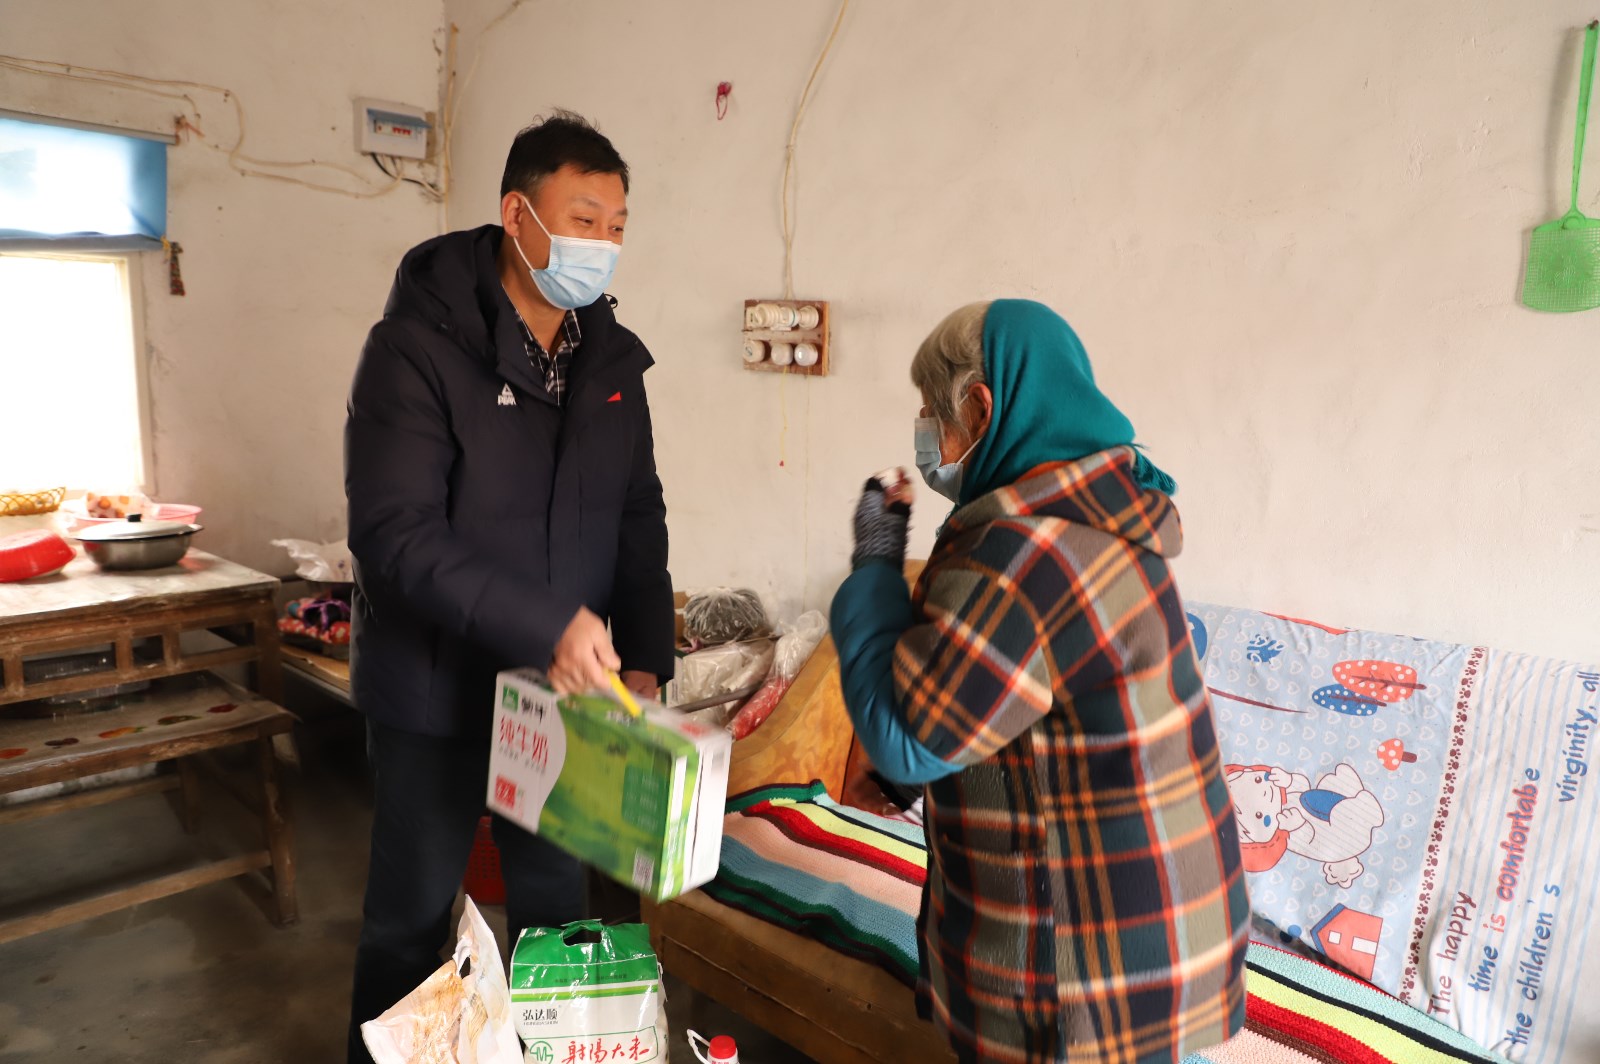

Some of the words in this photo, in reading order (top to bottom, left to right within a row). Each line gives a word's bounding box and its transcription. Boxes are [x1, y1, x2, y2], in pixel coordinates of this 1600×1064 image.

[500, 716, 548, 768] 纯牛奶
[1556, 705, 1598, 803] virginity,
[1436, 891, 1477, 962] happy
[1467, 945, 1498, 992] time
[1483, 913, 1506, 933] is
[523, 1008, 558, 1021] 弘达顺
[1427, 975, 1452, 1015] The
[1504, 1011, 1532, 1045] the
